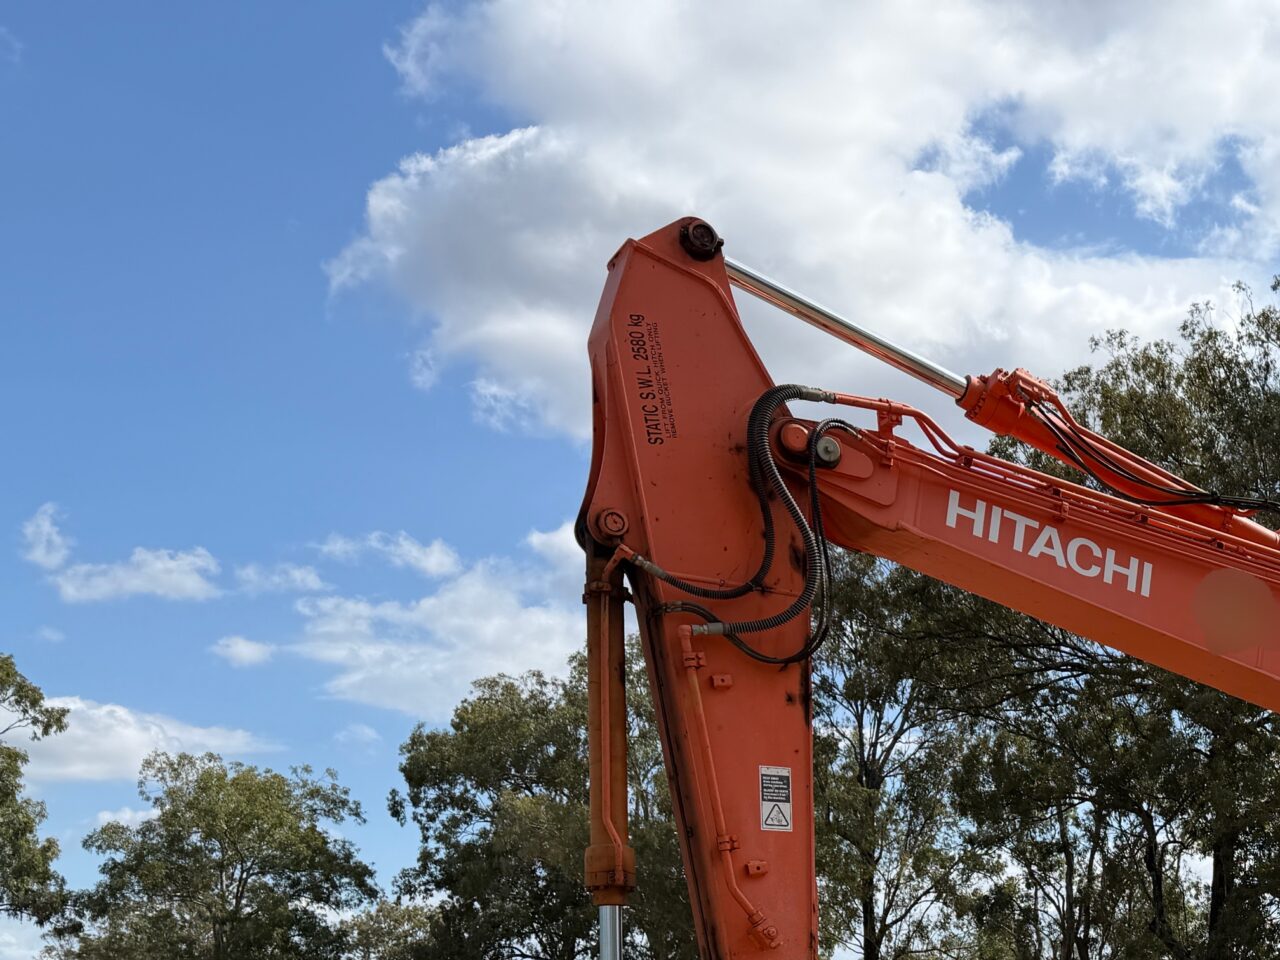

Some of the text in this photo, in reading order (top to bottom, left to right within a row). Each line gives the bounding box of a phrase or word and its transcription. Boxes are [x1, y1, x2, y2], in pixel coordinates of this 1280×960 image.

[628, 314, 664, 445] STATIC S.W.L. 2580 kg
[646, 322, 672, 438] LIFT FROM QUICK HITCH ONLY
[652, 322, 678, 438] REMOVE BUCKET WHEN LIFTING
[946, 489, 1153, 598] HITACHI
